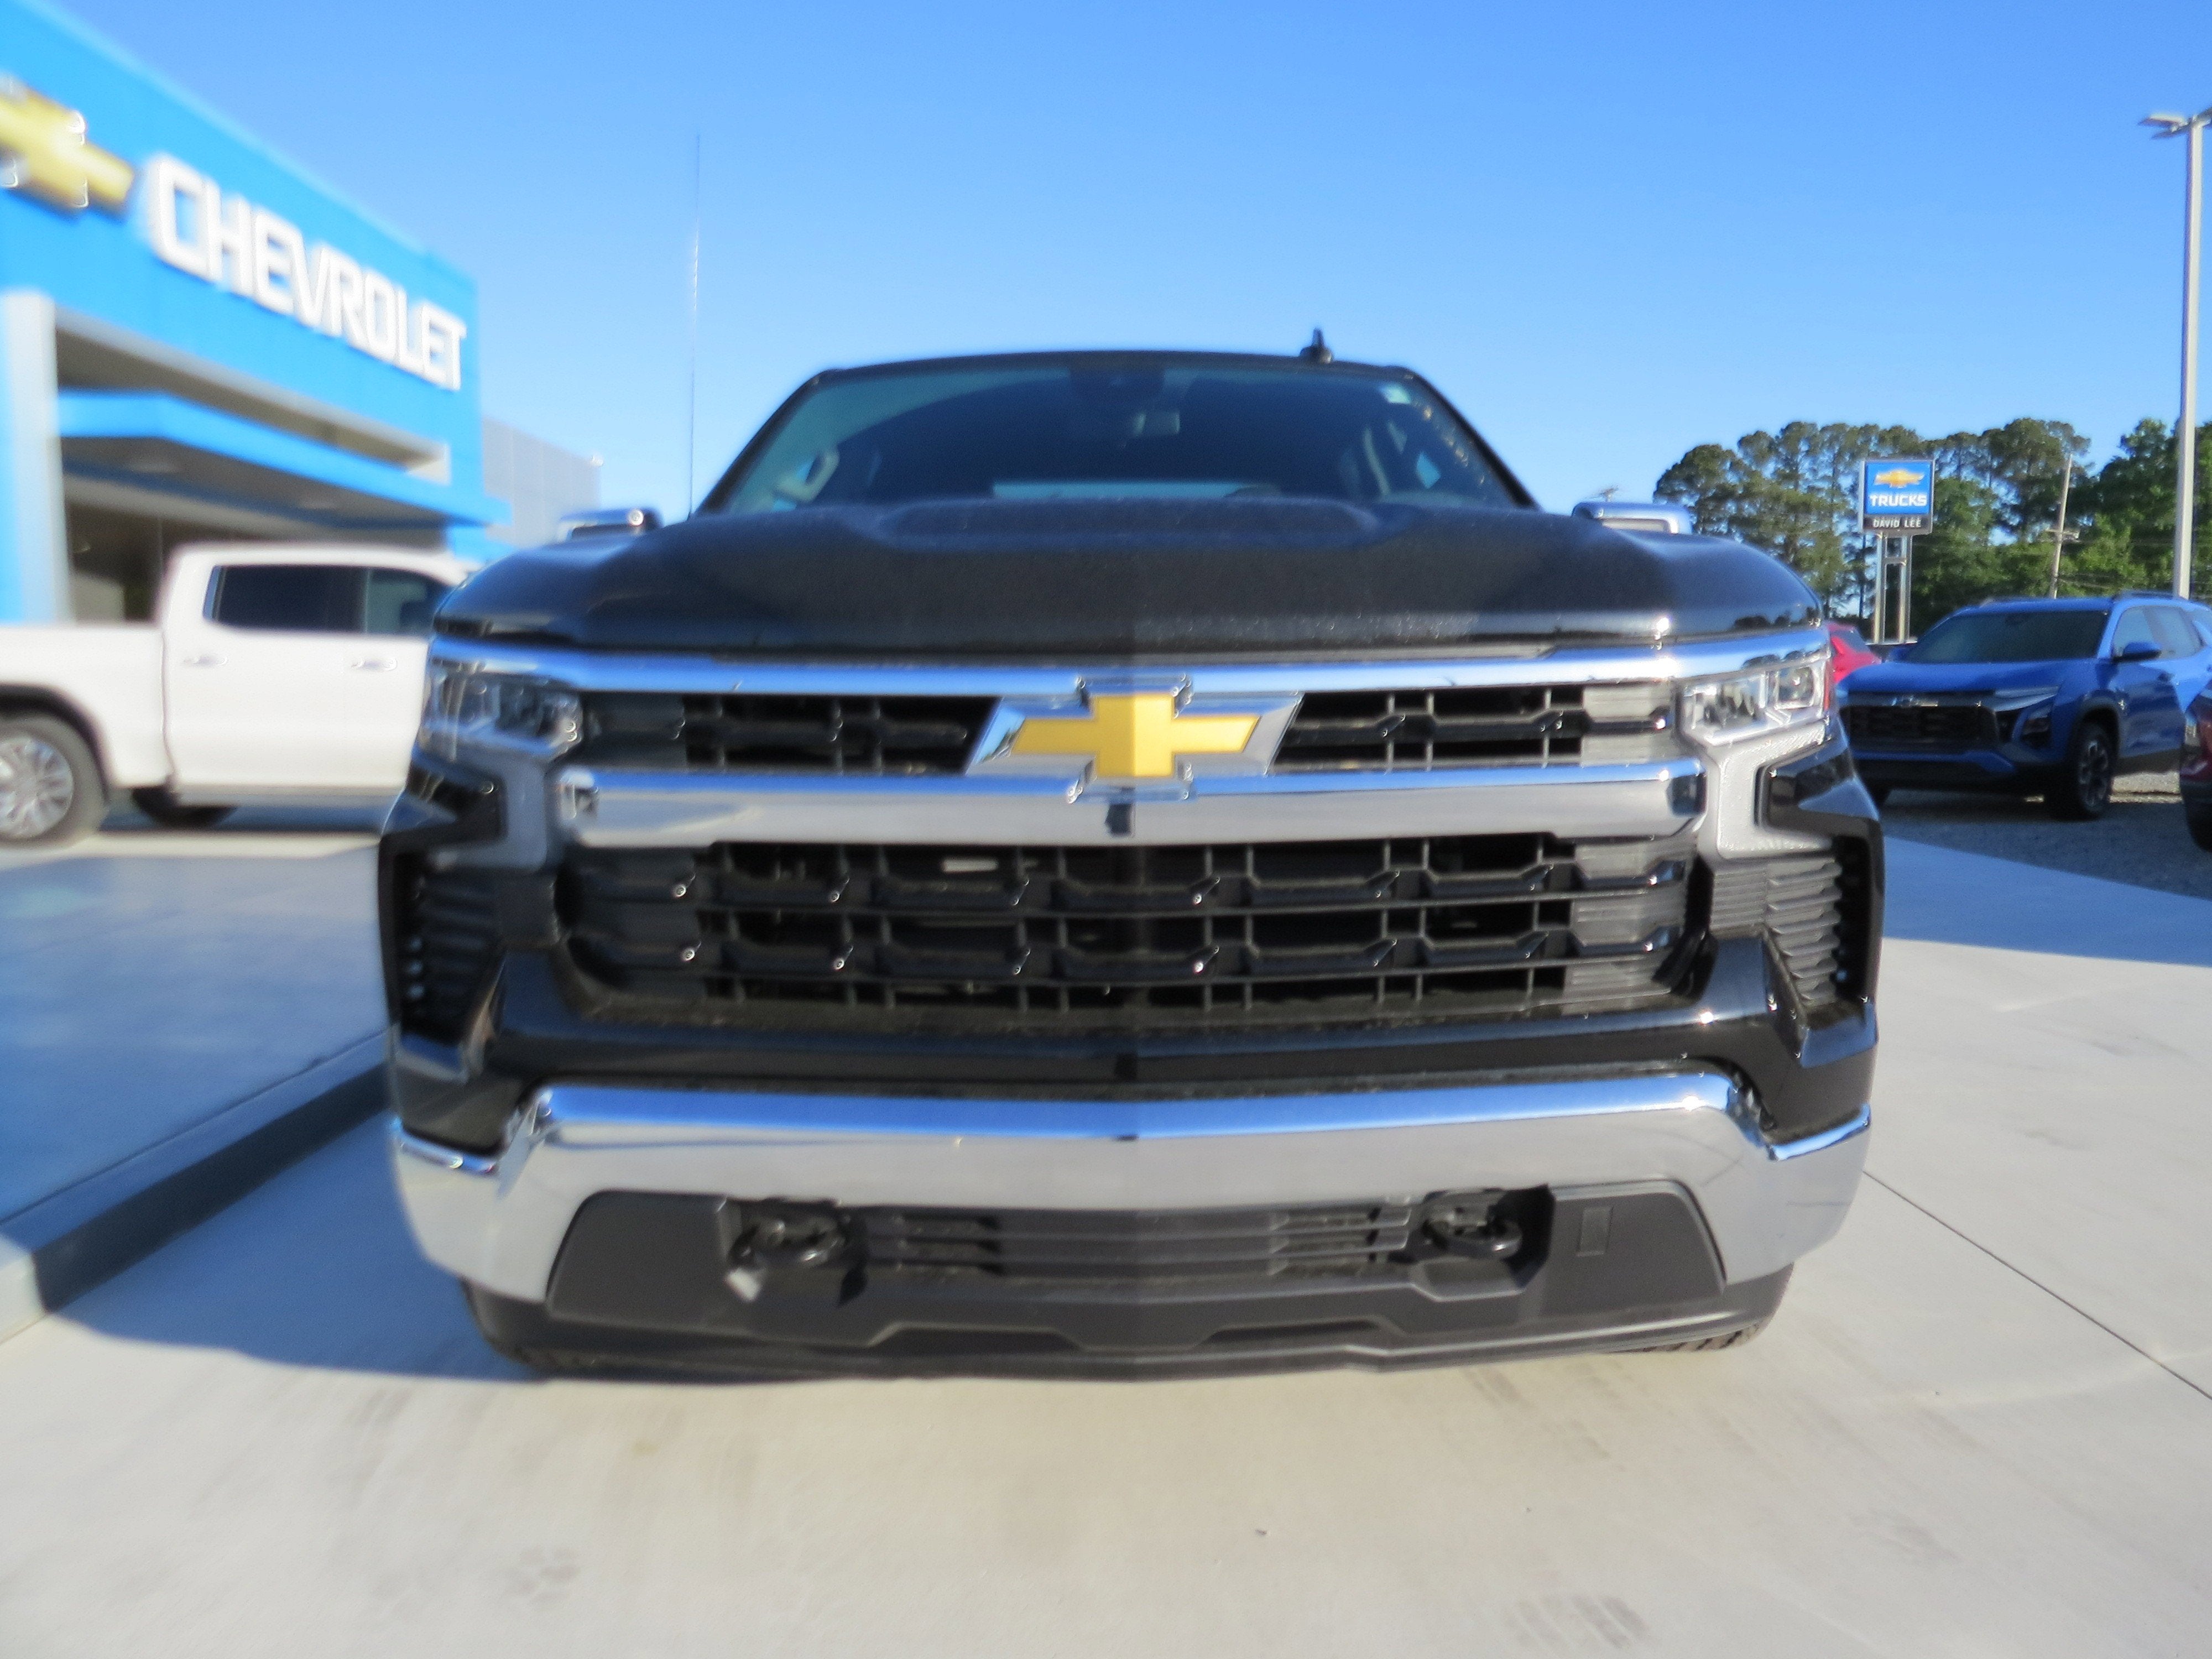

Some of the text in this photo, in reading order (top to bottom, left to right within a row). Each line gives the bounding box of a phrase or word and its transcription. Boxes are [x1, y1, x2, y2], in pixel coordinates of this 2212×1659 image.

[147, 152, 467, 391] CHEVROLET
[1870, 494, 1927, 507] TRUCKS
[1872, 518, 1922, 528] DAVID LEE
